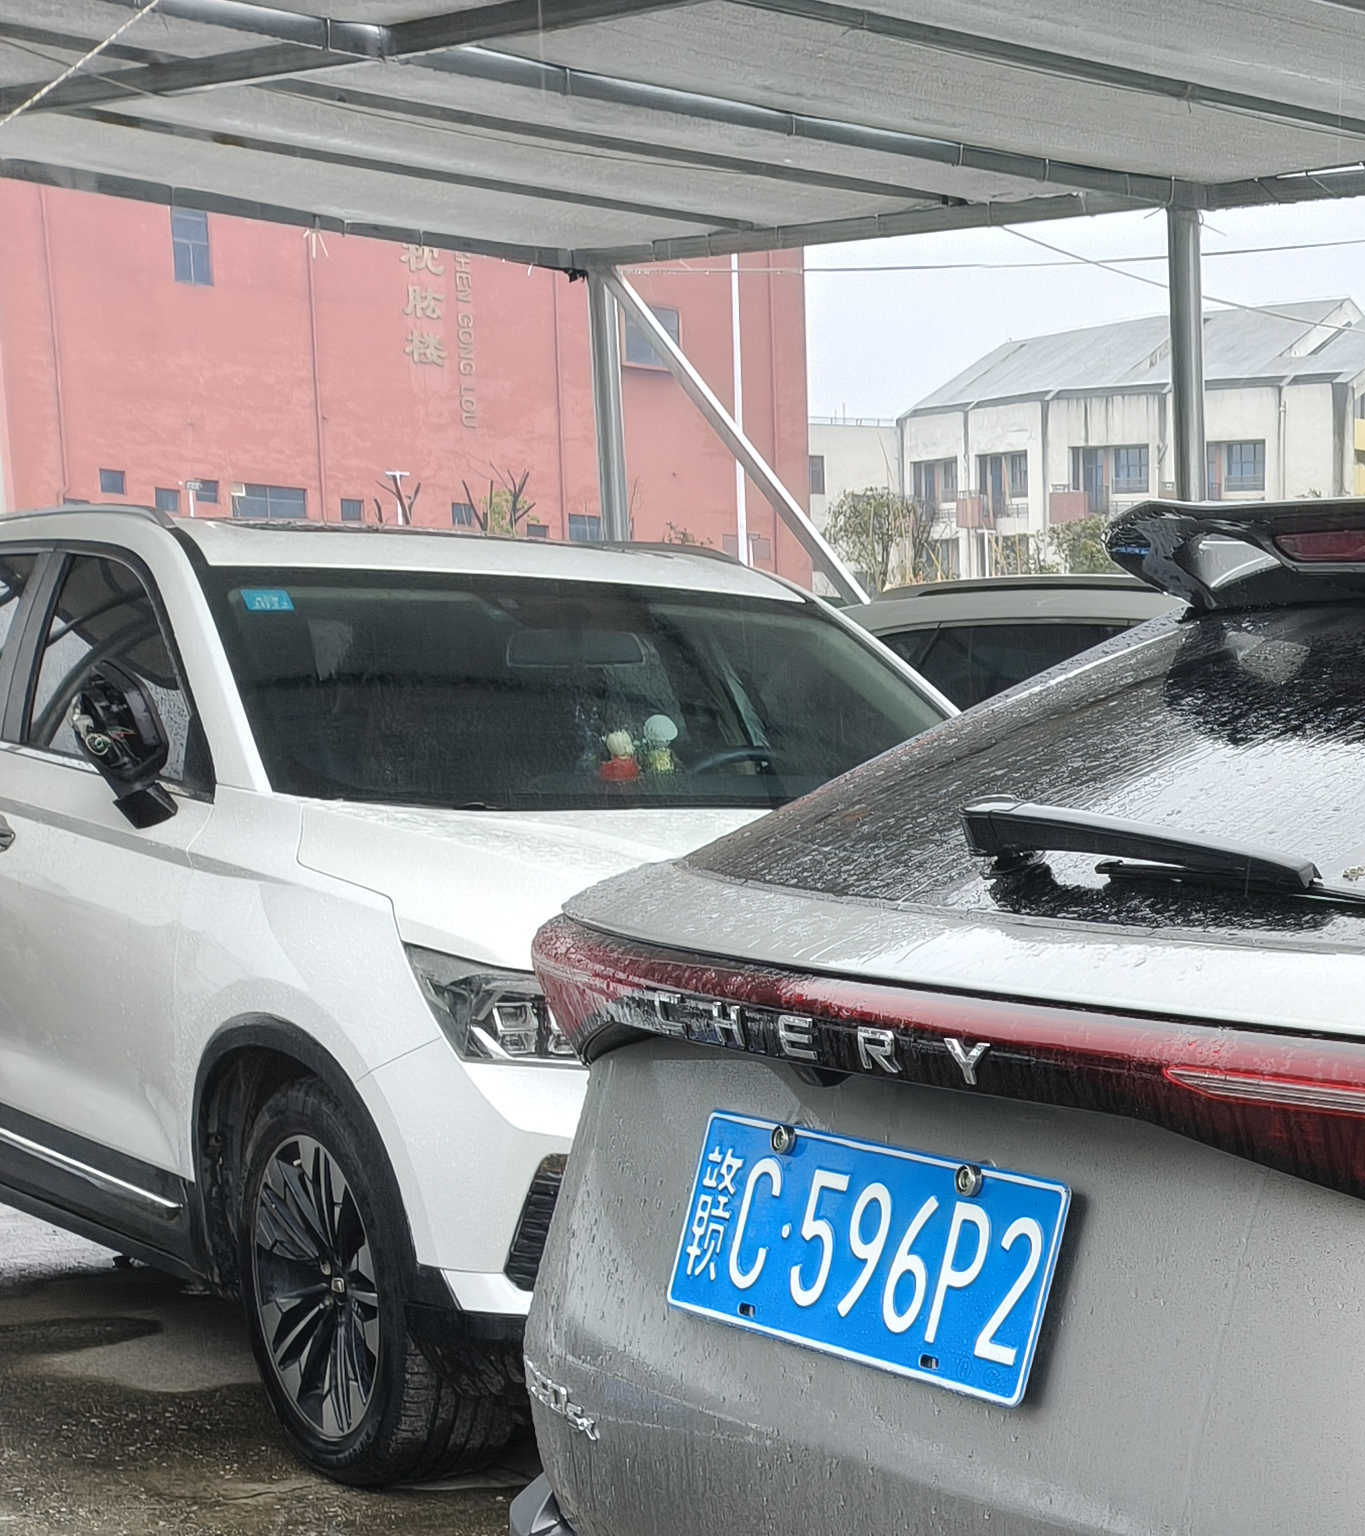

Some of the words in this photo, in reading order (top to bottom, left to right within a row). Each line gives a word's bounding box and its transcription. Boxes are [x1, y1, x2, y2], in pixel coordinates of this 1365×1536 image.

[456, 312, 475, 377] GONG
[459, 383, 477, 430] LOU
[653, 991, 991, 1085] CHERY
